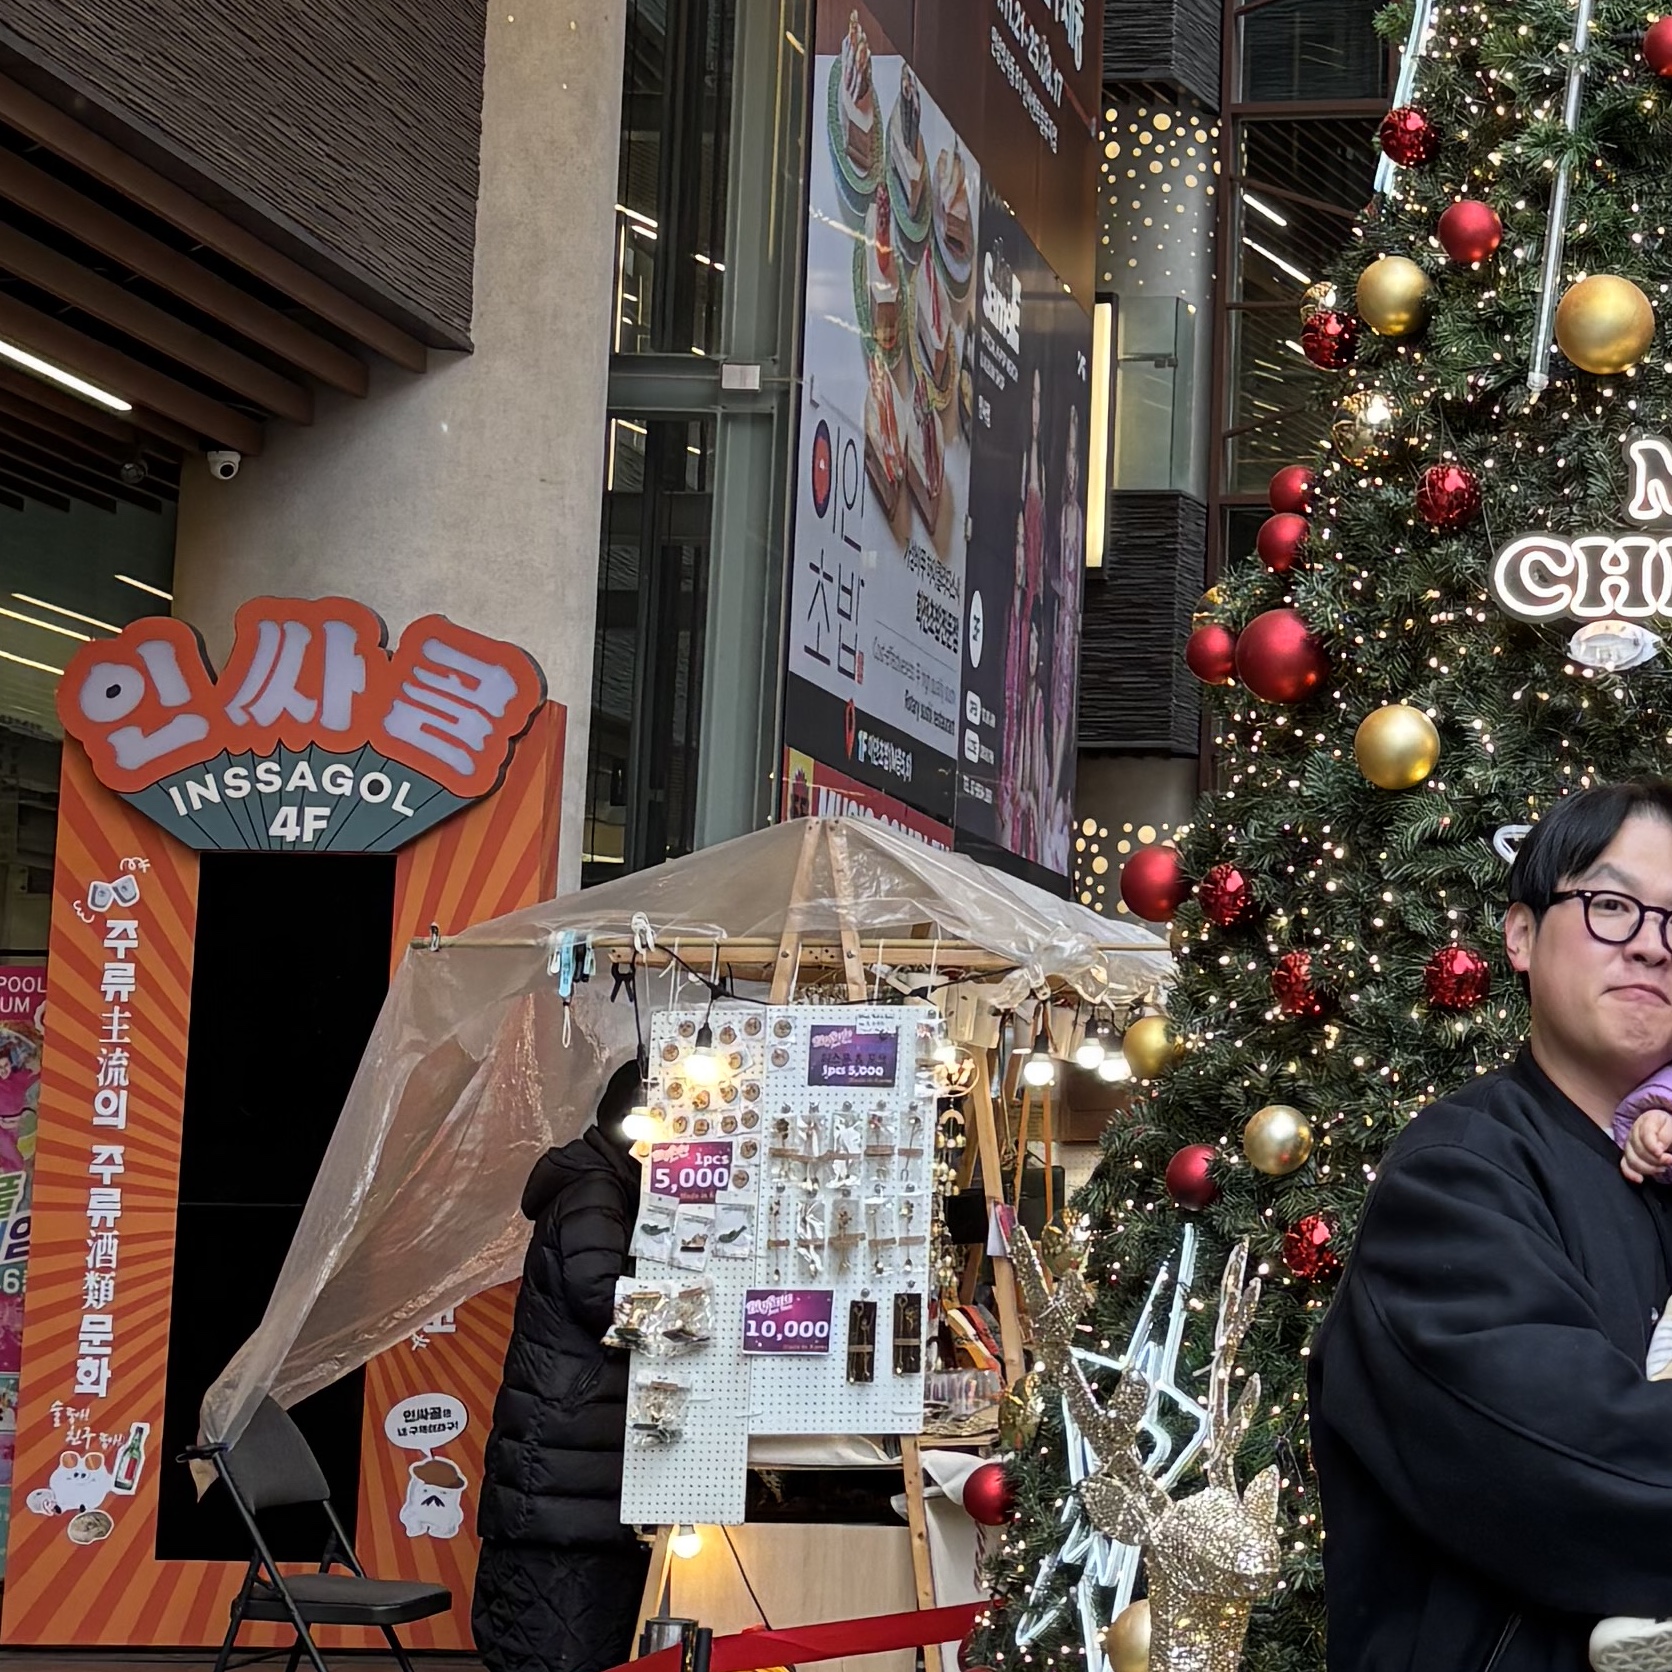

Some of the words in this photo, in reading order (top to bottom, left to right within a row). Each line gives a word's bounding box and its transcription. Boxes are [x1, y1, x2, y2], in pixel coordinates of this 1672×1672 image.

[79, 619, 518, 776] 인싸골
[168, 761, 415, 817] INSSAGOL
[268, 806, 331, 843] 4F
[92, 919, 139, 1130] 주류主流의
[848, 1066, 884, 1077] 5,000
[694, 1152, 730, 1167] 1pcs
[654, 1168, 729, 1193] 5,000
[746, 1320, 829, 1341] 10,000
